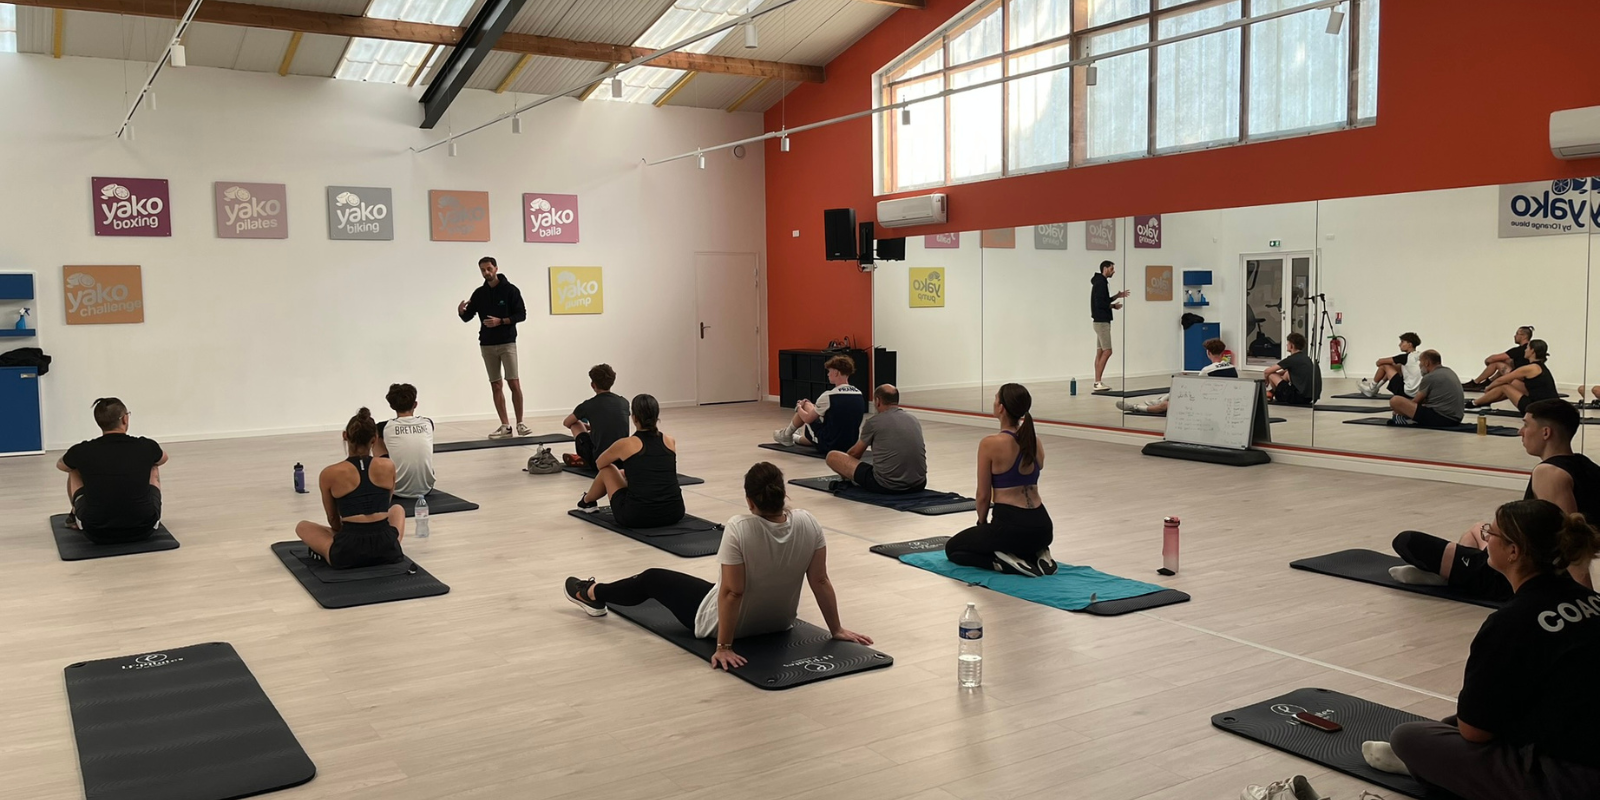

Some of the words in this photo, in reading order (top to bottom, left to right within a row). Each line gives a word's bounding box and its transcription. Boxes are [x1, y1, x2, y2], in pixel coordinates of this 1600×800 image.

[101, 195, 163, 225] yako
[113, 216, 158, 229] boxing
[224, 197, 281, 225] yako
[336, 202, 387, 229] yako
[438, 206, 486, 231] yako
[530, 207, 574, 233] yako
[236, 217, 278, 233] pilates
[346, 221, 379, 234] biking
[67, 283, 128, 313] yako
[557, 279, 598, 304] yako
[564, 297, 591, 310] pump
[80, 299, 142, 317] challenge
[1537, 594, 1600, 632] COAC
